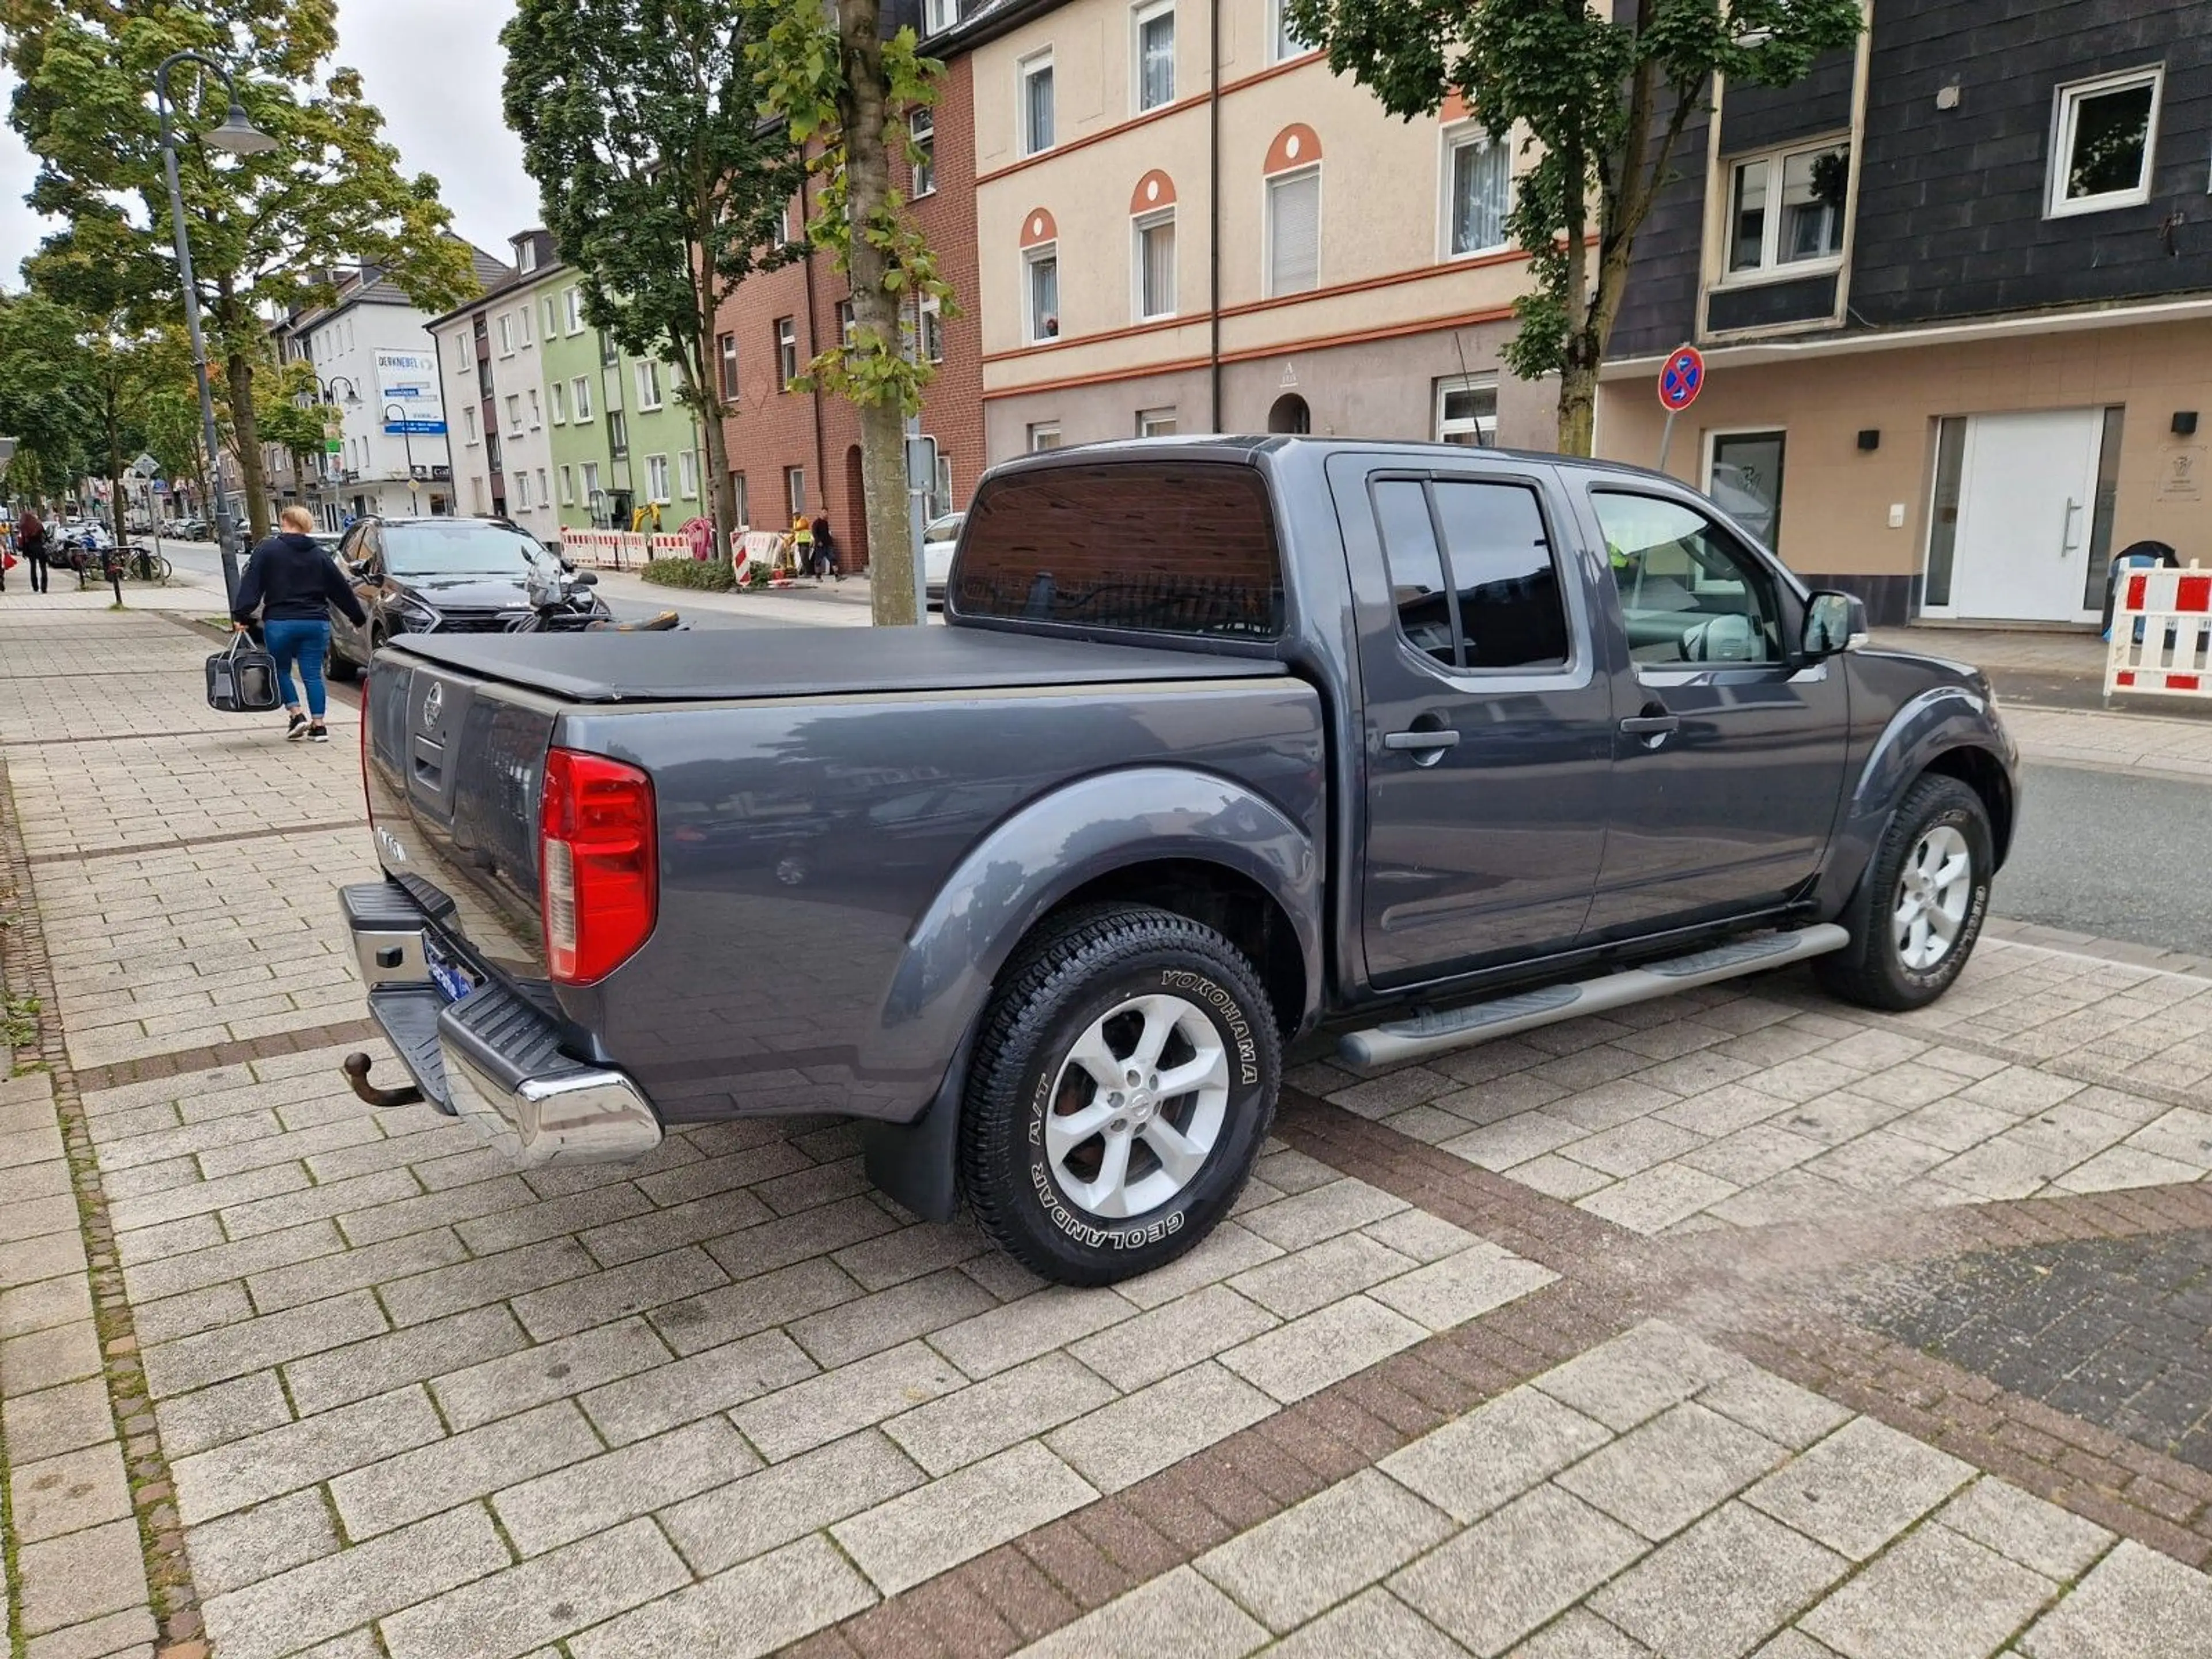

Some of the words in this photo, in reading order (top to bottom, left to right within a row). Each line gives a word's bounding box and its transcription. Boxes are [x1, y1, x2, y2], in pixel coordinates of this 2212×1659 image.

[1161, 971, 1257, 1085] YOKOHAMA
[1028, 1073, 1049, 1146] A/T
[1031, 1162, 1185, 1250] GEOLANDAR
